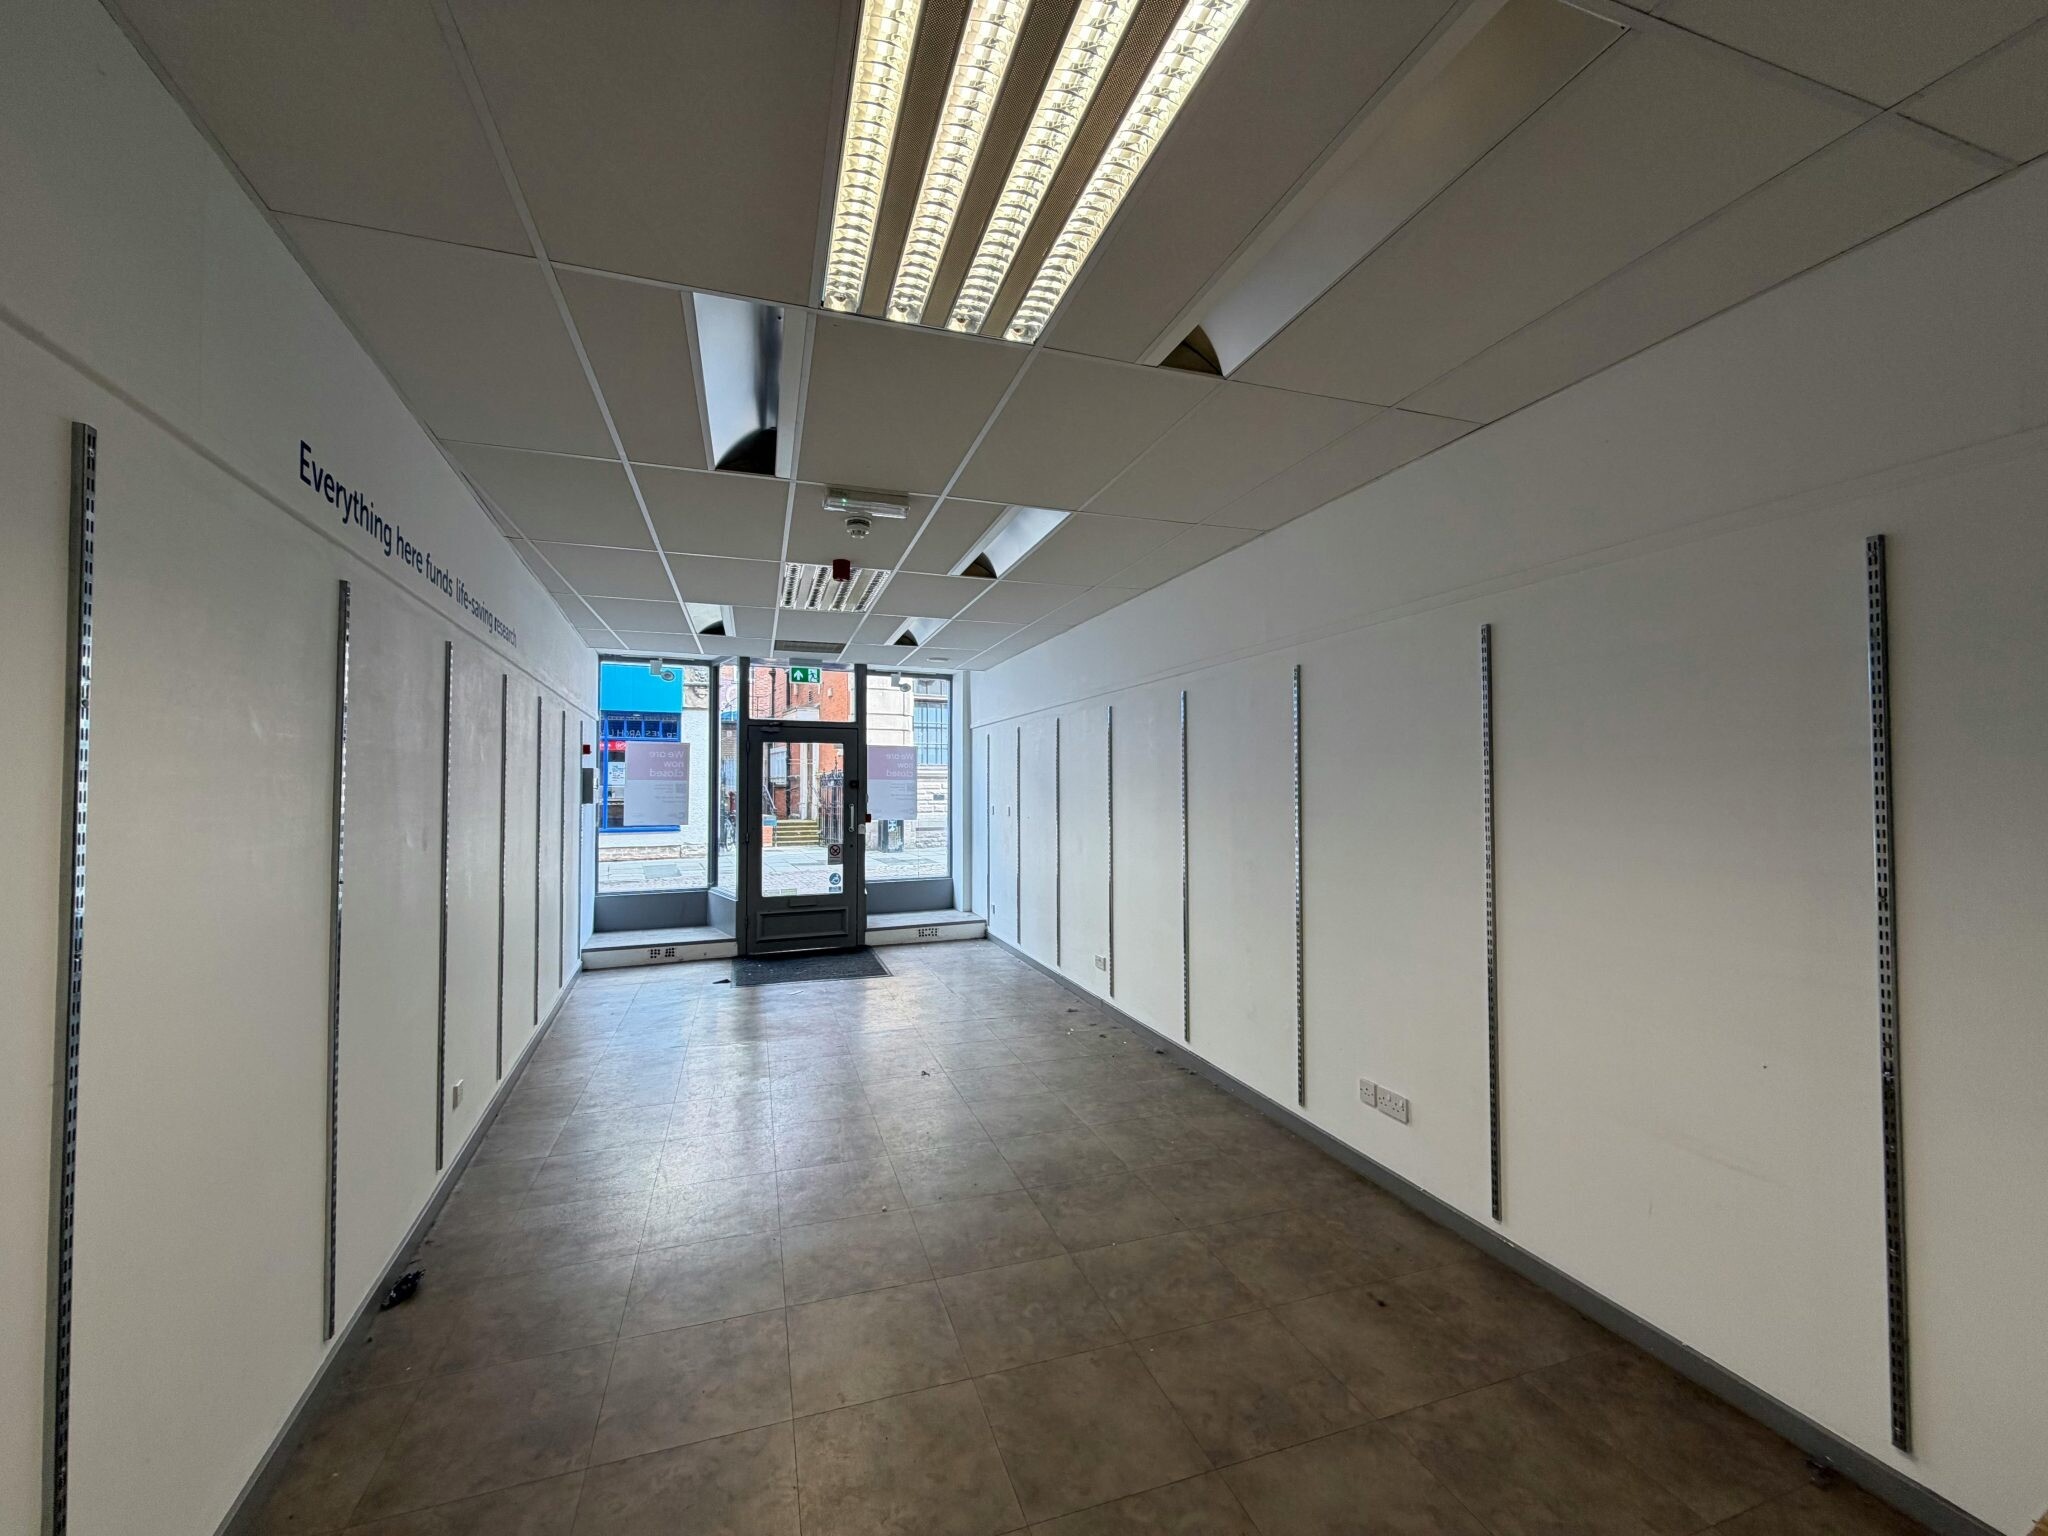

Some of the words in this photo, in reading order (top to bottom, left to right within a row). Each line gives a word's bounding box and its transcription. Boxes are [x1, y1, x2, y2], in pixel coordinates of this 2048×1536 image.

[299, 440, 392, 556] Everything
[397, 525, 423, 573] here
[425, 553, 453, 597] funds
[456, 577, 493, 633] life-saving
[494, 616, 517, 648] research
